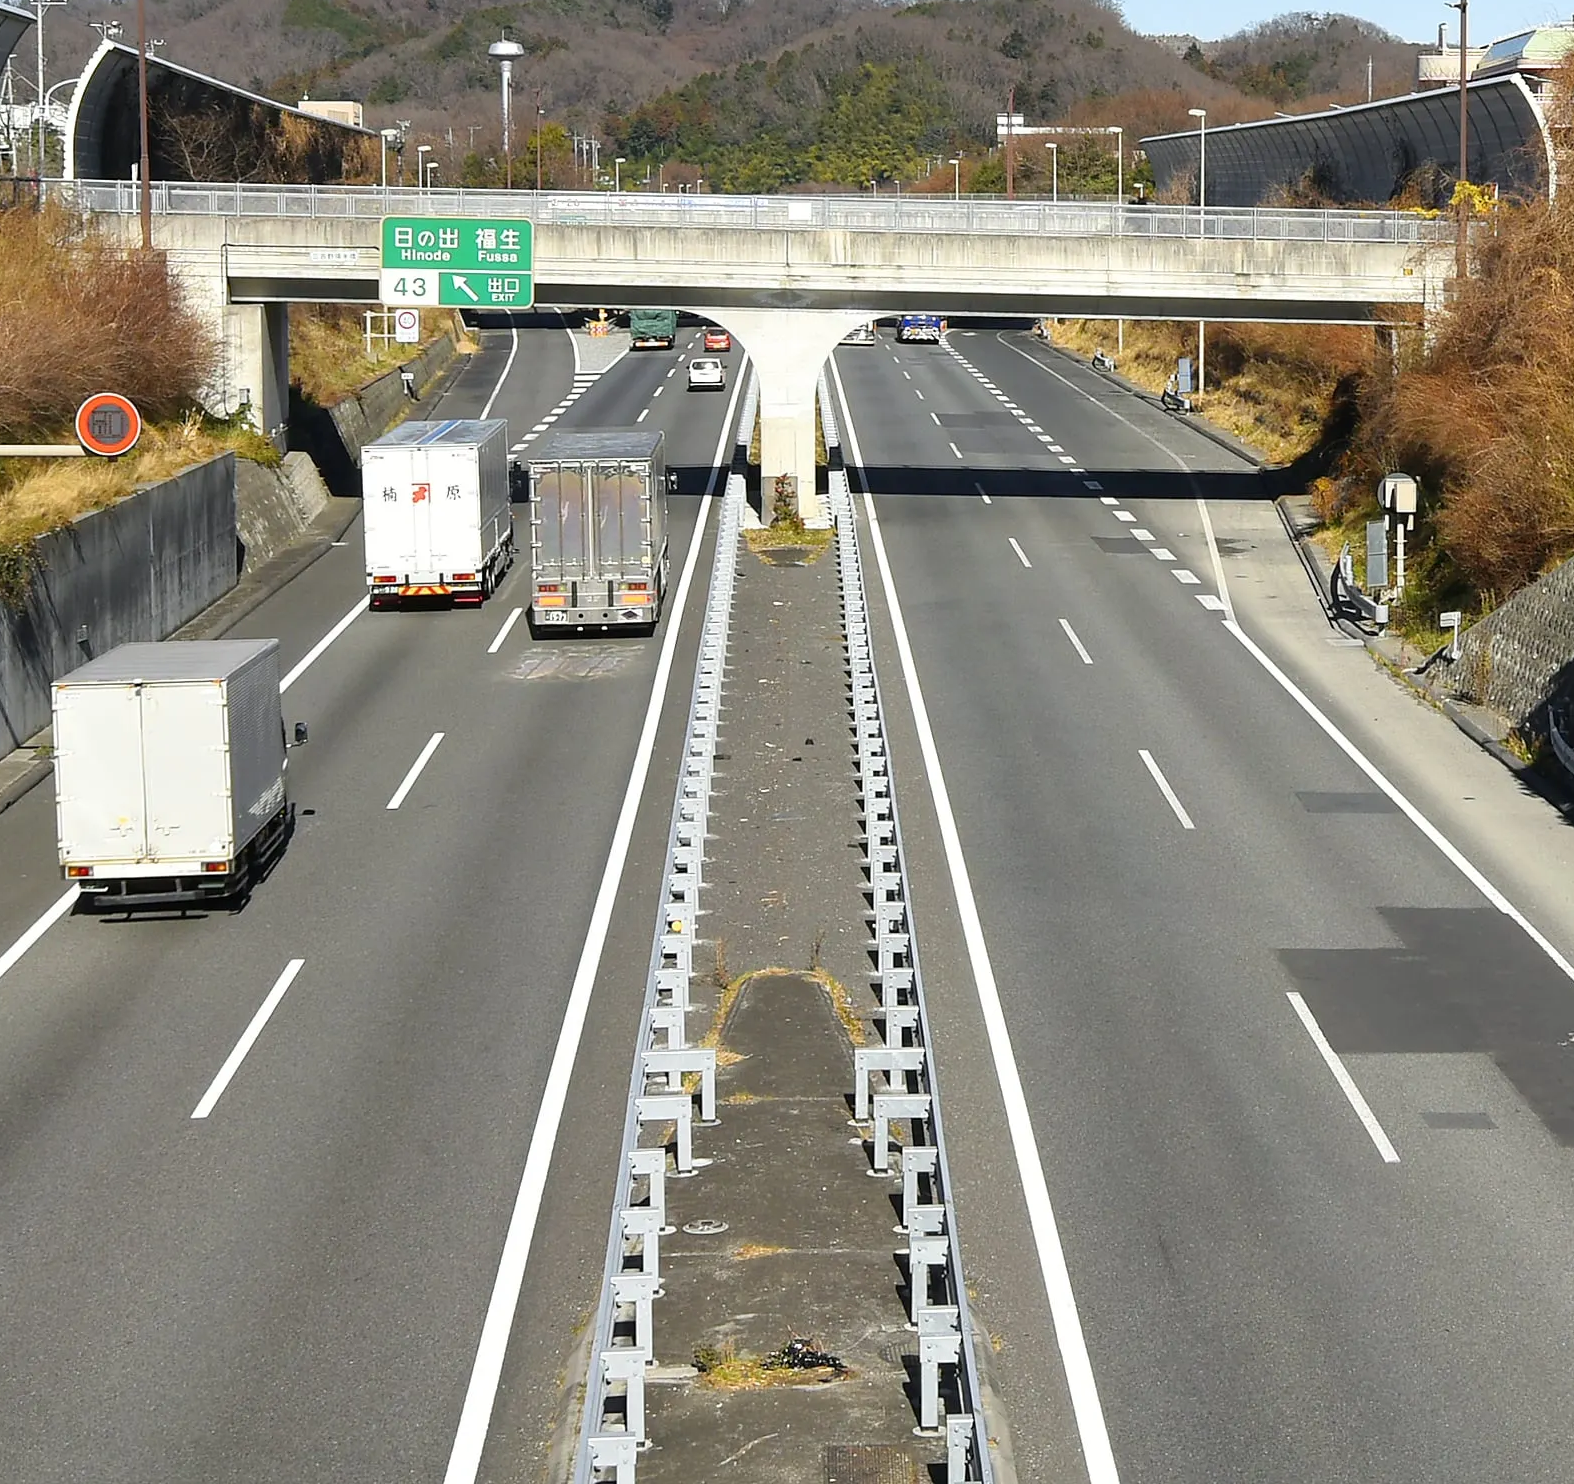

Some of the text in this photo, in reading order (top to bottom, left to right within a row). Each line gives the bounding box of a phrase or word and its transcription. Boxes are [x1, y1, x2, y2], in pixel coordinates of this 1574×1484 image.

[394, 227, 521, 250] 日の出 福生
[401, 249, 518, 263] Hinode Fussa
[393, 277, 427, 296] 43
[487, 277, 520, 293] 出口
[491, 293, 515, 302] EXIT
[446, 485, 461, 501] 原
